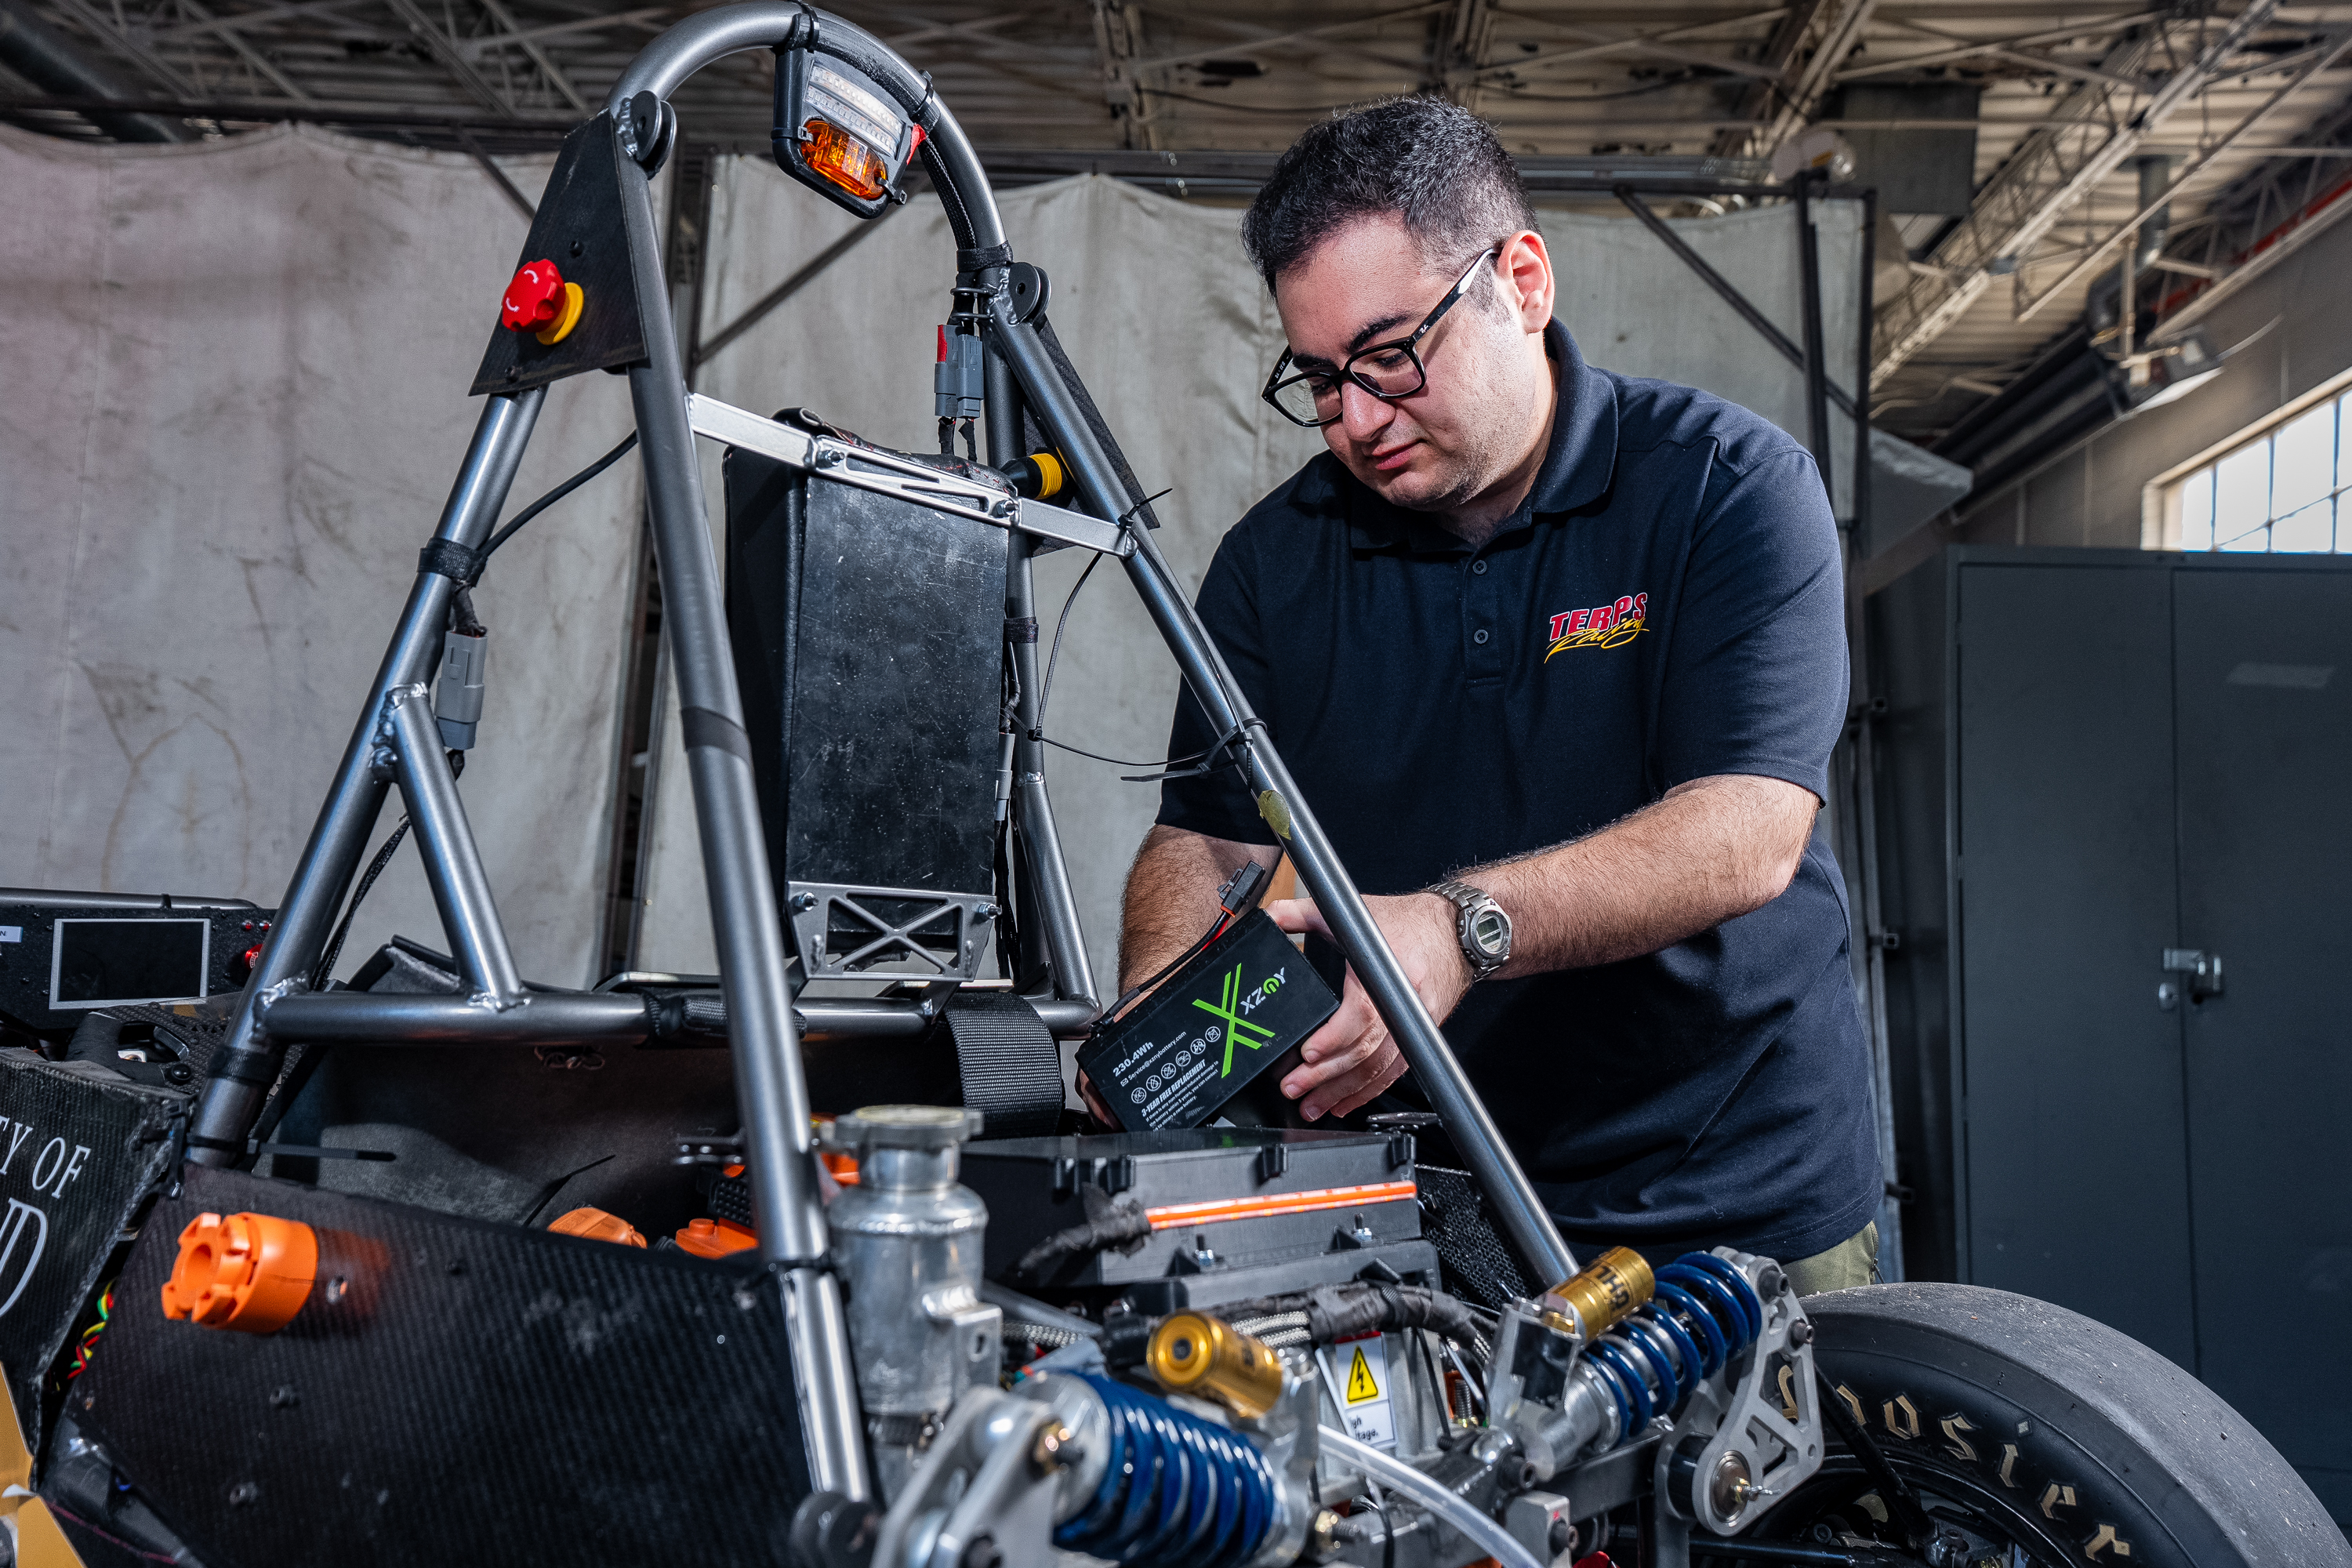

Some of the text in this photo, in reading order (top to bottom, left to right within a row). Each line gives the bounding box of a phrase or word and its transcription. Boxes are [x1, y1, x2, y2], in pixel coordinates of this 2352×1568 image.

[1544, 616, 1650, 664] Racing
[1549, 592, 1648, 641] TERPS
[1112, 1042, 1154, 1077] 230.4Wh
[1127, 1031, 1187, 1080] Service@xznybattery.com
[1142, 1058, 1206, 1117] 3-YEAR FREE REPLACEMENT
[1149, 1110, 1159, 1120] there
[1200, 1064, 1214, 1077] damage
[1155, 1110, 1169, 1123] battery
[1167, 1101, 1179, 1112] within
[1204, 1069, 1218, 1081] contact
[1161, 1114, 1174, 1125] obtain
[1175, 1105, 1184, 1114] new
[32, 1137, 92, 1200] OF
